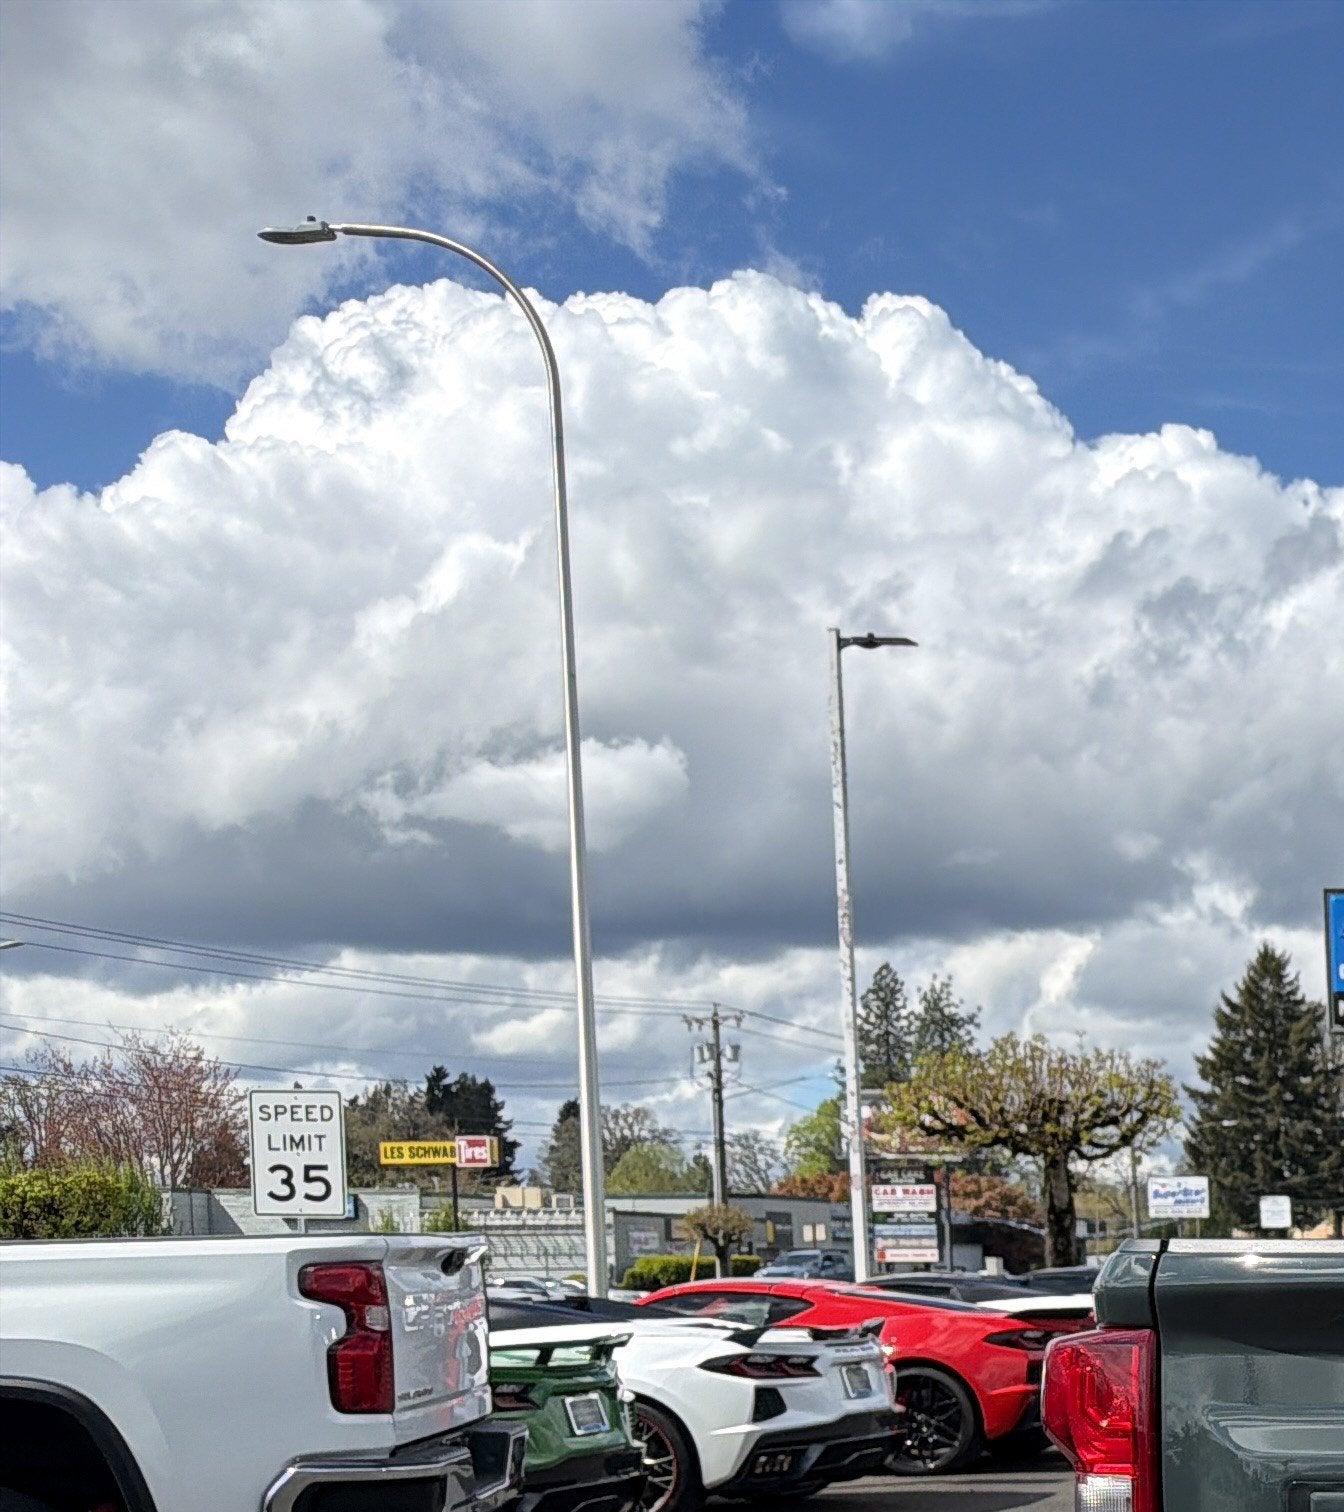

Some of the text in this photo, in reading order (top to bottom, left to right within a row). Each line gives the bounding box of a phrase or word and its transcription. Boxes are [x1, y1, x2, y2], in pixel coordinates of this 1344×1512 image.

[258, 1104, 334, 1122] SPEED
[267, 1133, 327, 1152] LIMIT
[383, 1145, 456, 1160] LES SCHWAB
[267, 1163, 332, 1202] 35
